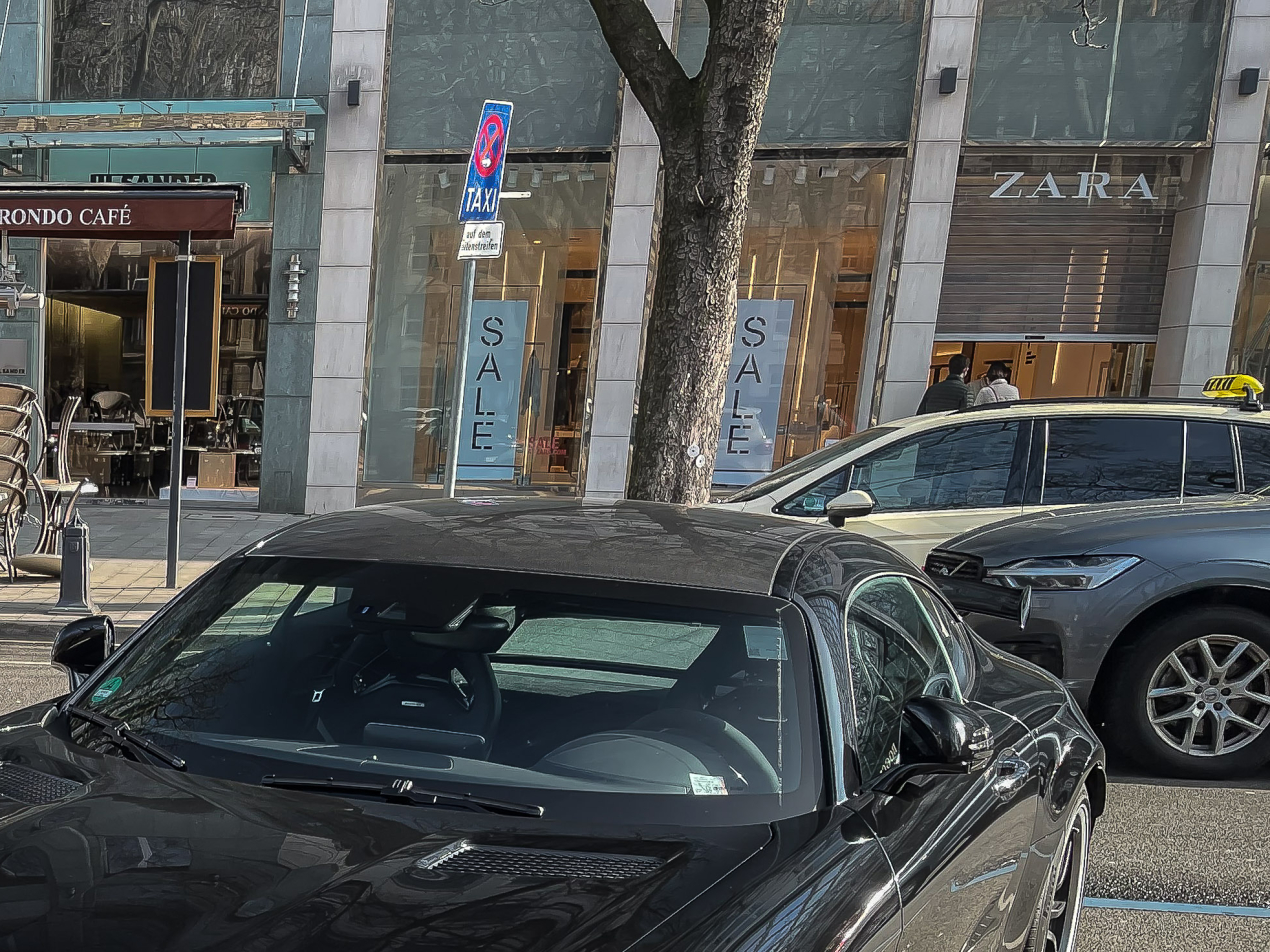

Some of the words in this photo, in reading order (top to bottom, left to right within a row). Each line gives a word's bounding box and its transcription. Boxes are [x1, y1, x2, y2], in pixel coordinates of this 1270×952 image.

[989, 172, 1159, 199] ZARA
[466, 187, 497, 212] TAXI
[79, 204, 132, 226] CAFÉ
[466, 229, 476, 239] auf
[478, 230, 491, 239] dem
[471, 316, 504, 450] SALE
[726, 316, 766, 455] SALE
[1206, 378, 1232, 391] TAXI
